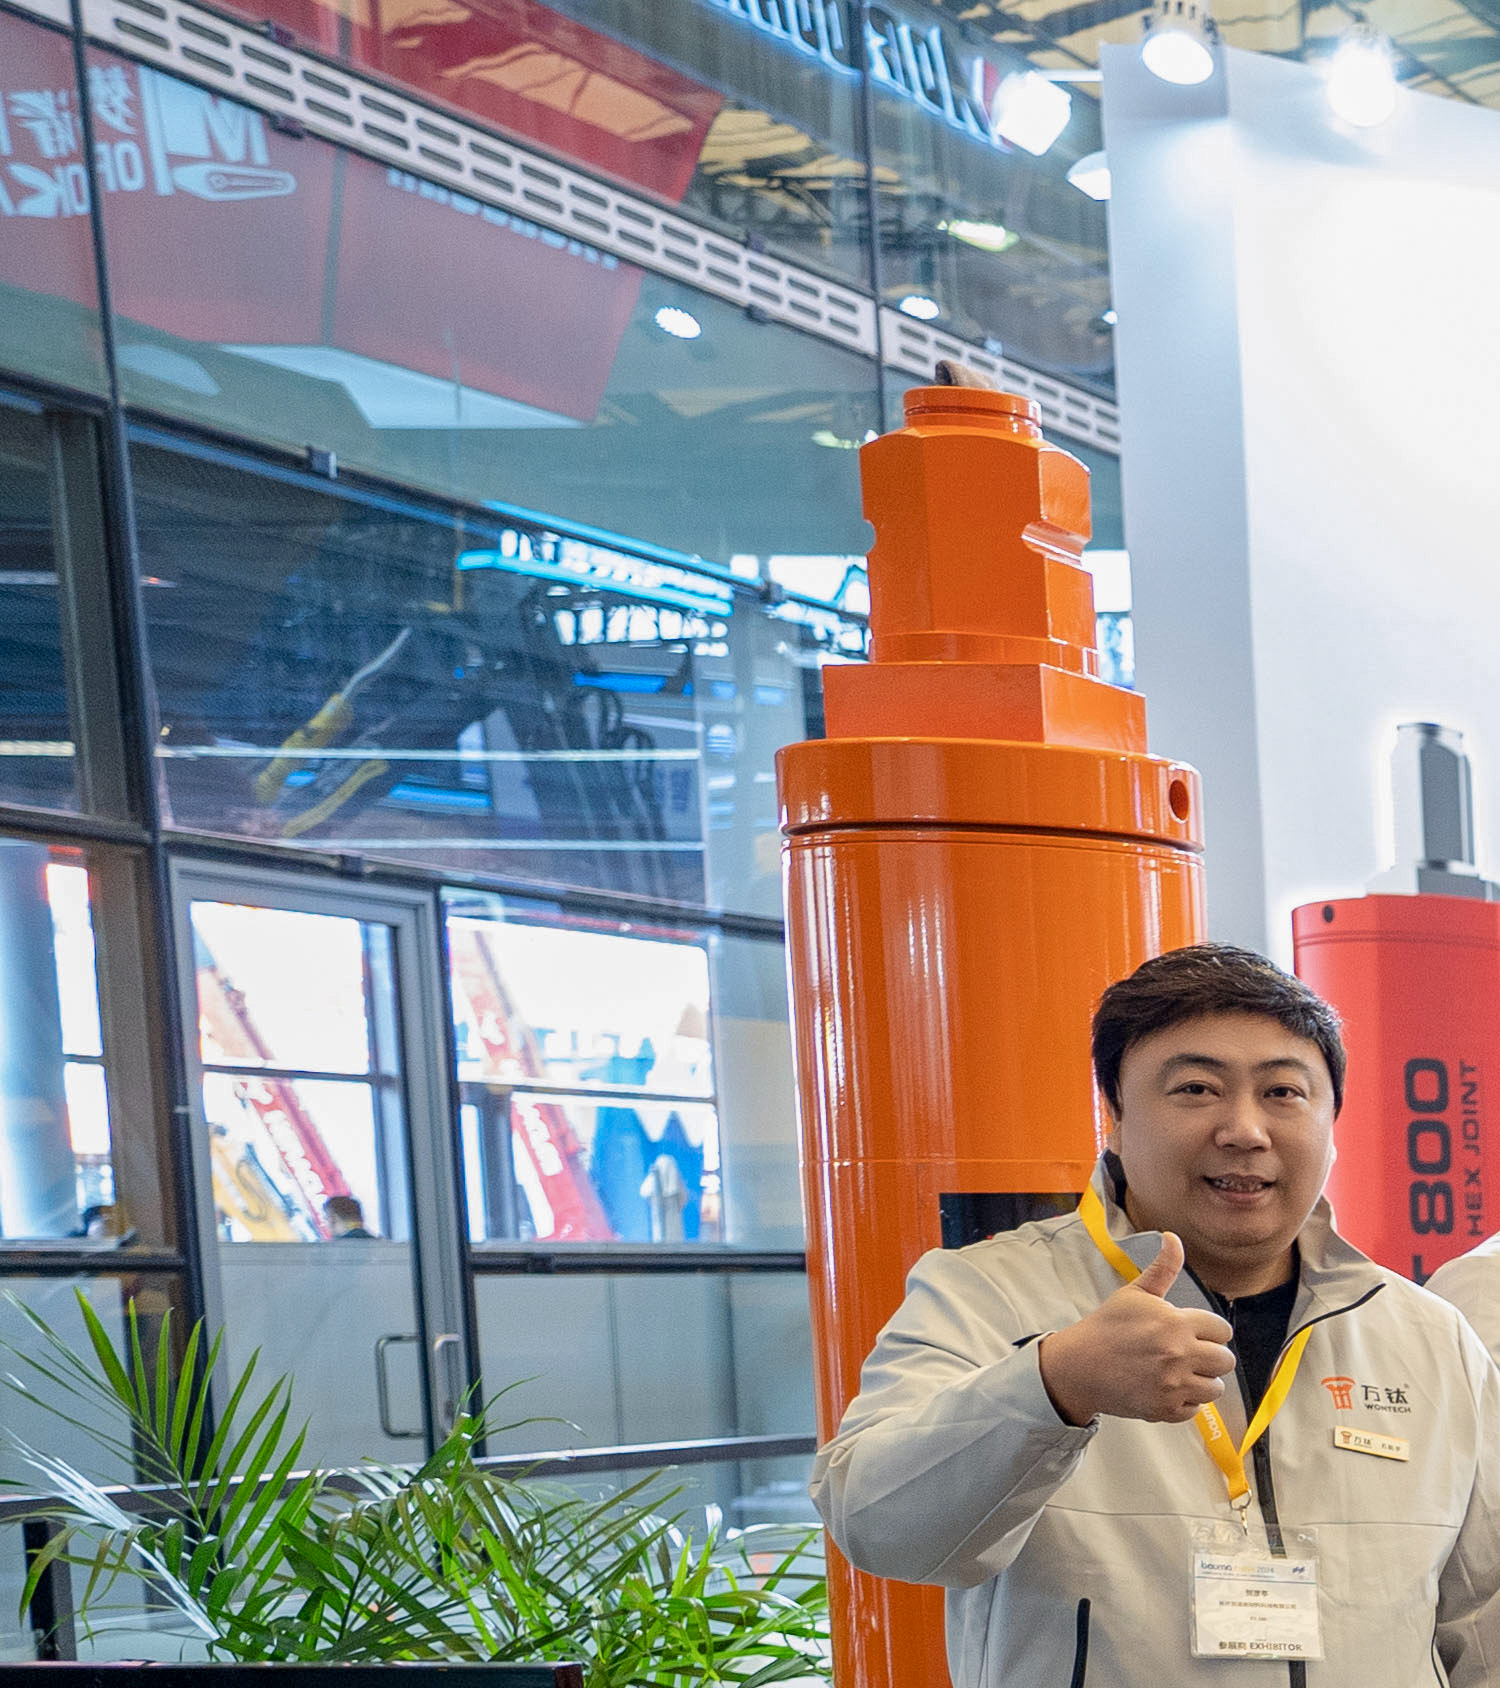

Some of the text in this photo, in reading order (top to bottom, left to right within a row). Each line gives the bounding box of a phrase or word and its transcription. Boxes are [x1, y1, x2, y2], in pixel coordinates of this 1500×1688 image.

[1404, 1057, 1456, 1236] 800
[1459, 1059, 1484, 1237] HEX JOINT
[1365, 1403, 1412, 1414] WONTECH
[1249, 1641, 1303, 1651] EXHIBITOR
